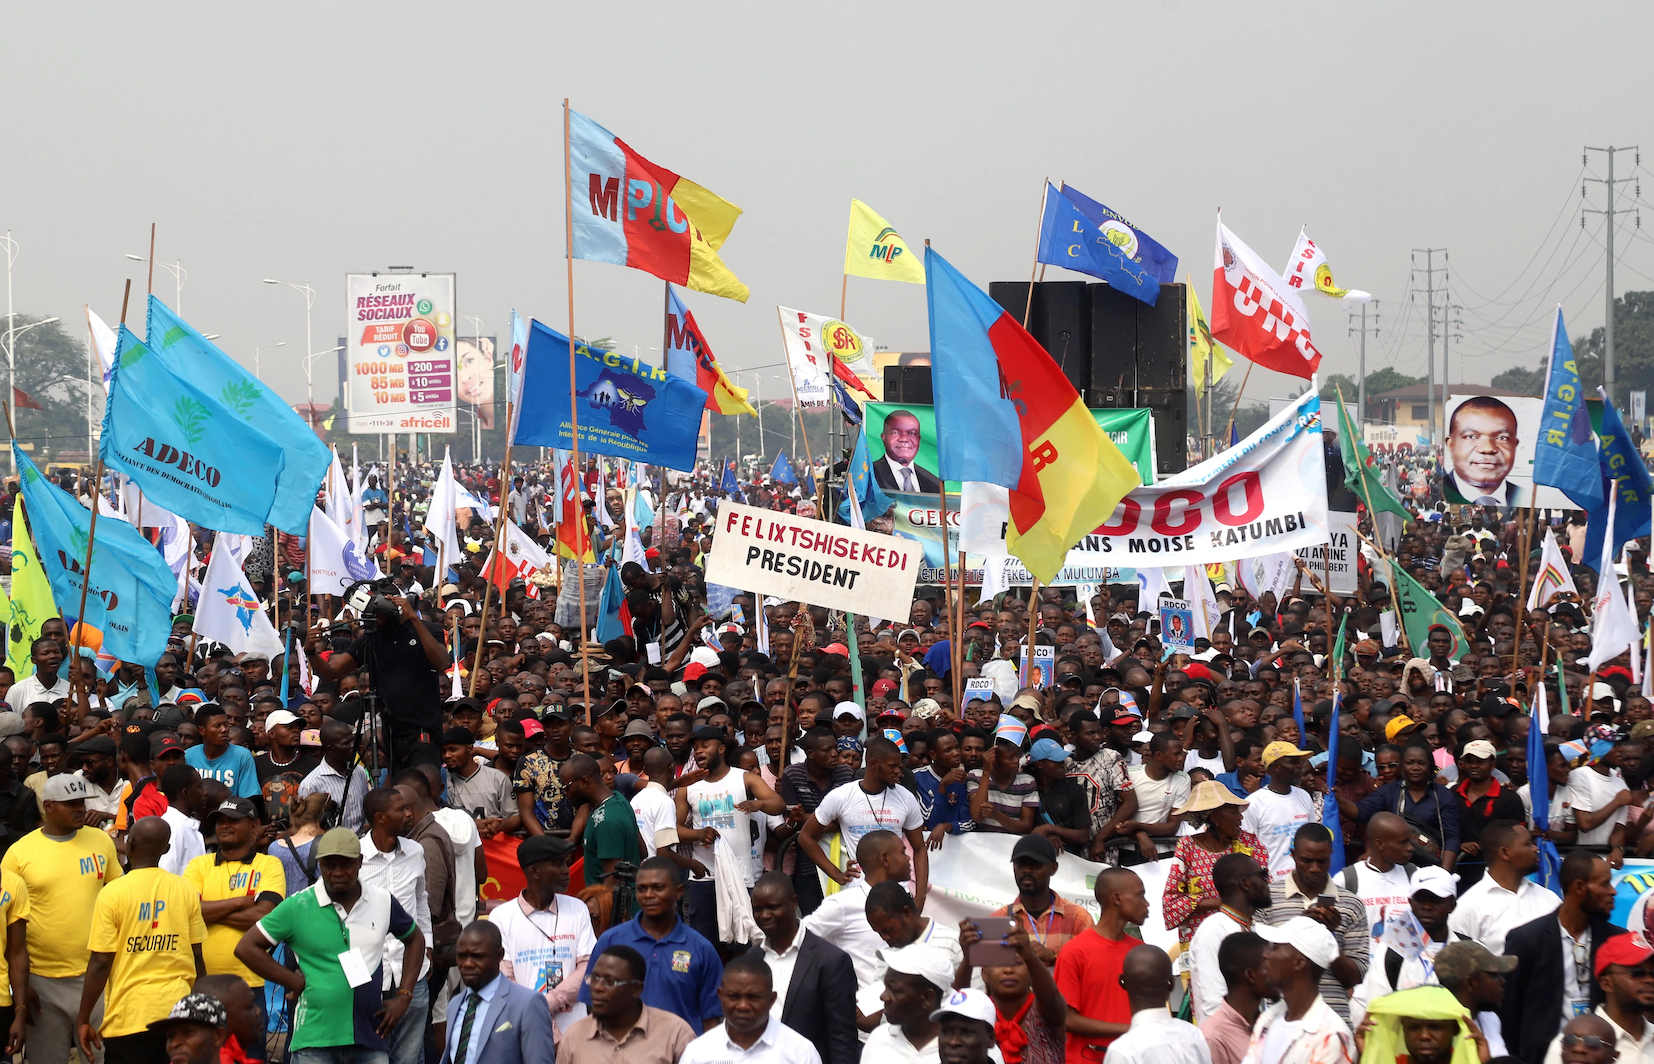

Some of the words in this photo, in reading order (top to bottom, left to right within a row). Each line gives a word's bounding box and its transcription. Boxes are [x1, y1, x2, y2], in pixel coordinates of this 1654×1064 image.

[869, 244, 903, 264] MLP
[376, 284, 401, 292] Forfait
[357, 293, 416, 308] RÉSEAUX
[357, 306, 413, 321] SOCIAUX
[376, 326, 395, 334] TARIF
[413, 324, 426, 334] You
[374, 333, 399, 341] RÉDUIT
[412, 335, 428, 345] Tube
[400, 417, 450, 428] africell
[560, 421, 588, 431] Allince
[559, 430, 585, 440] Intéts
[133, 437, 221, 488] ADECO
[147, 465, 160, 475] DES
[1072, 536, 1112, 553] ANS
[1129, 535, 1194, 553] MOISE
[1210, 512, 1306, 548] KATUMBI
[745, 546, 860, 590] PRESIDENT
[1309, 561, 1349, 573] PHILBERT
[1064, 568, 1120, 580] MULUMBA
[1164, 600, 1187, 610] RDCO
[970, 680, 989, 689] RDCO
[79, 853, 106, 880] MLP
[138, 900, 165, 929] MLP
[126, 934, 179, 952] SECURITE
